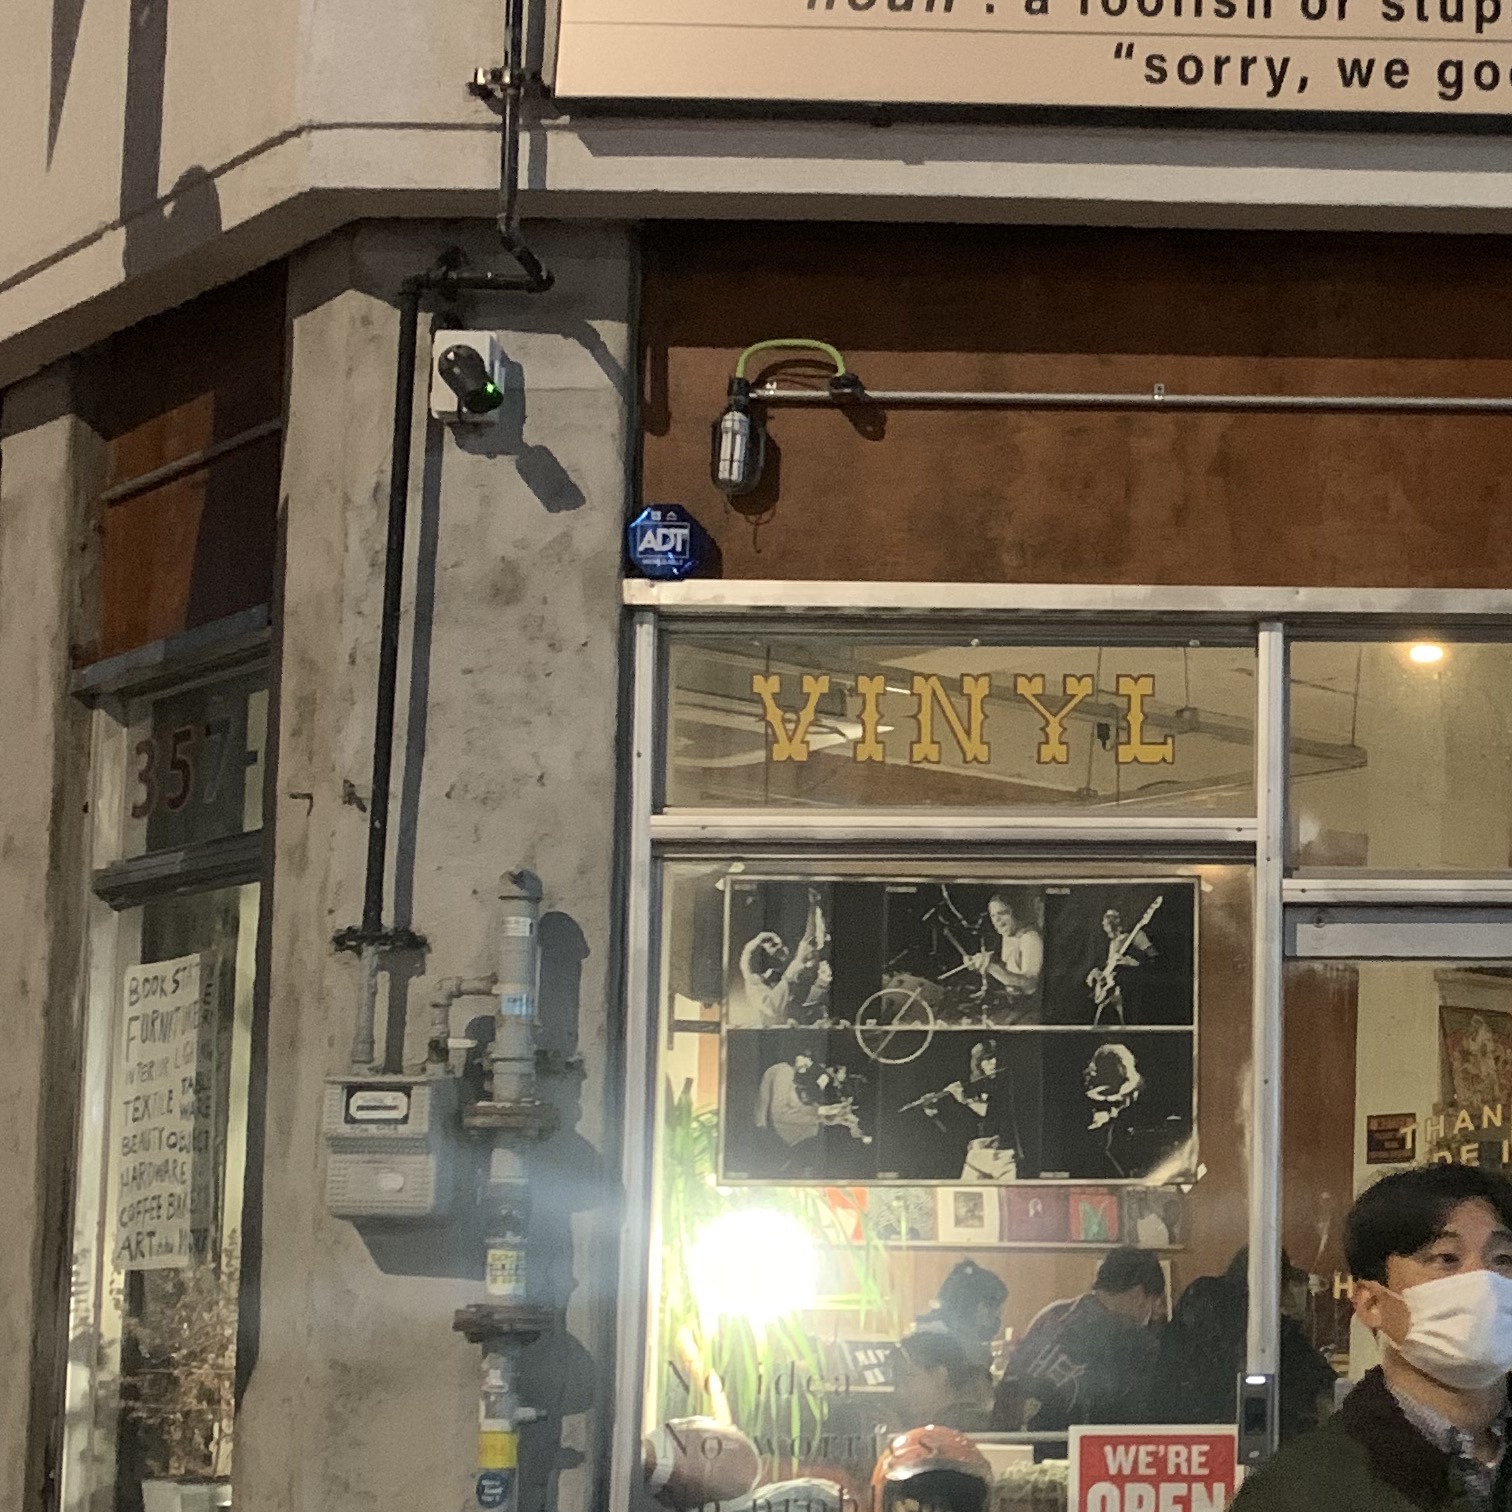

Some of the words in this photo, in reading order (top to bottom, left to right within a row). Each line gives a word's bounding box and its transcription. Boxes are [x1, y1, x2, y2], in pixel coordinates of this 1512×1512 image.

[1337, 56, 1410, 89] we
[637, 527, 689, 552] ADT
[752, 673, 1175, 766] VINYL
[116, 1228, 157, 1264] ART
[663, 1422, 723, 1460] No
